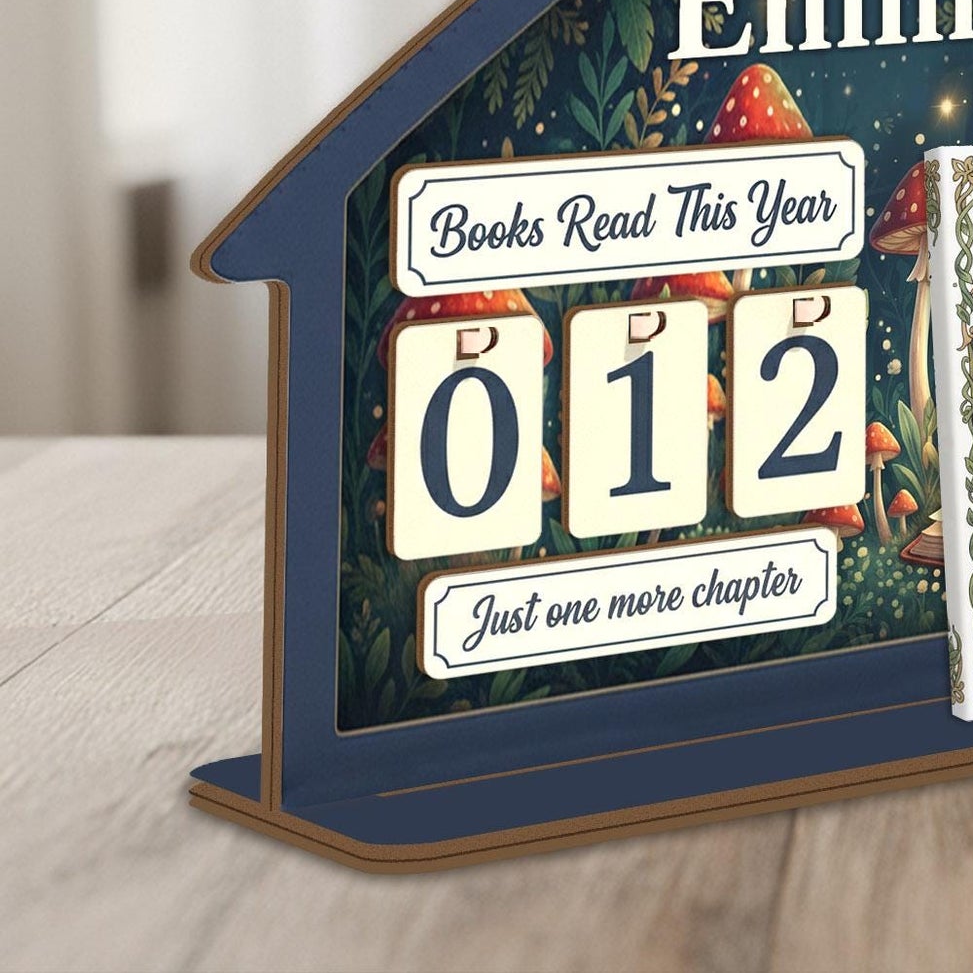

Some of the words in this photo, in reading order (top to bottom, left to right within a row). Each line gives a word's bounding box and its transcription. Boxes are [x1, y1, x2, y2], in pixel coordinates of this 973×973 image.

[430, 203, 544, 258] Books
[557, 193, 657, 252] Read
[667, 182, 738, 237] This
[747, 178, 838, 247] Year
[420, 366, 519, 518] 0
[607, 350, 671, 497] 1
[758, 335, 842, 480] 2
[462, 592, 541, 653] Just
[546, 601, 600, 628] one
[607, 583, 684, 620] more
[692, 561, 803, 615] chapter
